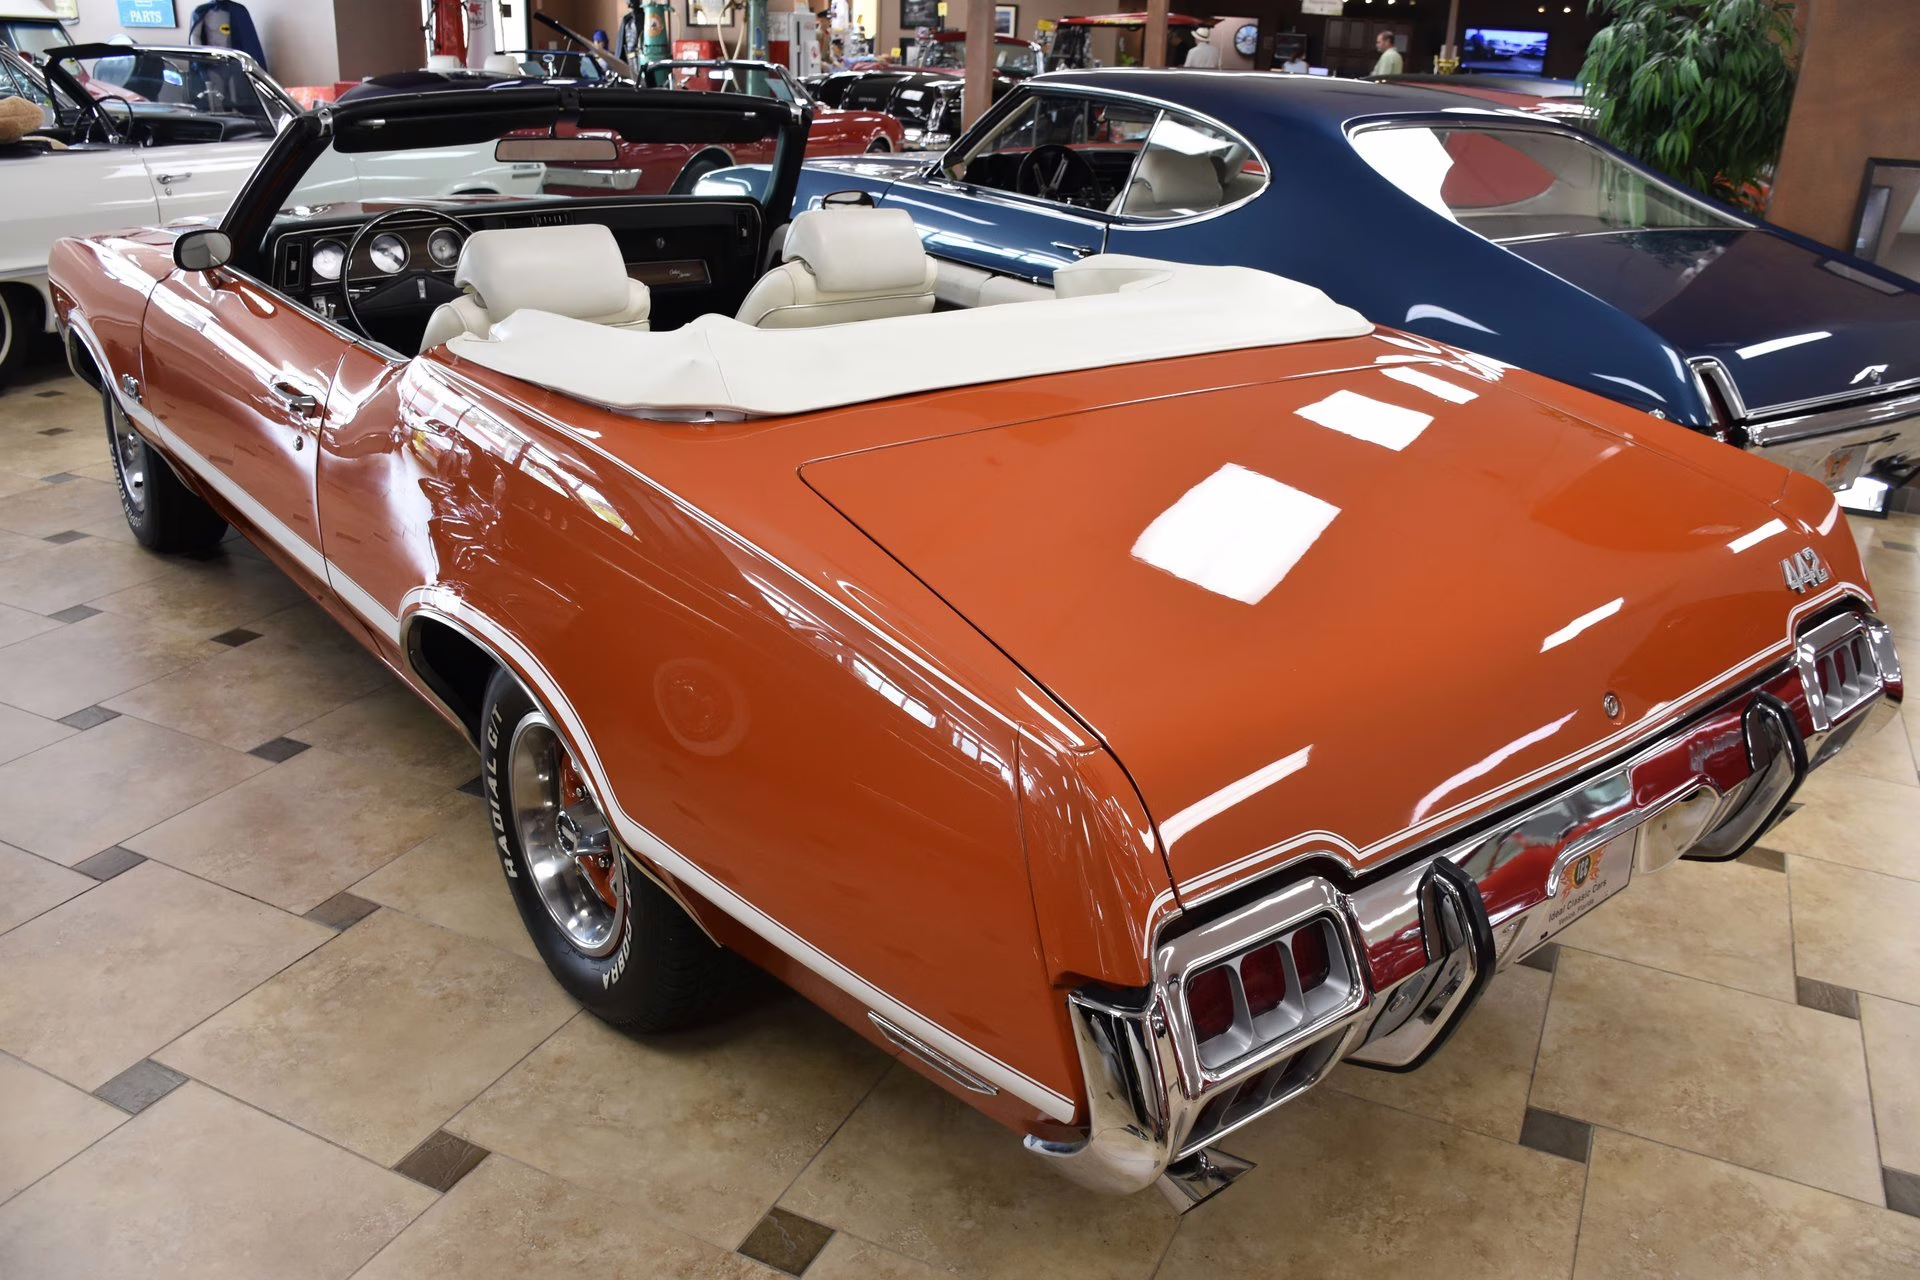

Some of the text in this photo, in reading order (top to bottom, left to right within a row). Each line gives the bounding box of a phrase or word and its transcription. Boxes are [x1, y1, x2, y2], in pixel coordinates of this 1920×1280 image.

[129, 10, 163, 23] PARTS
[1780, 546, 1829, 594] 442
[486, 703, 518, 878] RADIAL G/T
[1548, 905, 1566, 922] Ideal
[1567, 889, 1591, 910] Classic
[1592, 879, 1607, 893] Cars
[602, 915, 632, 990] COBRA
